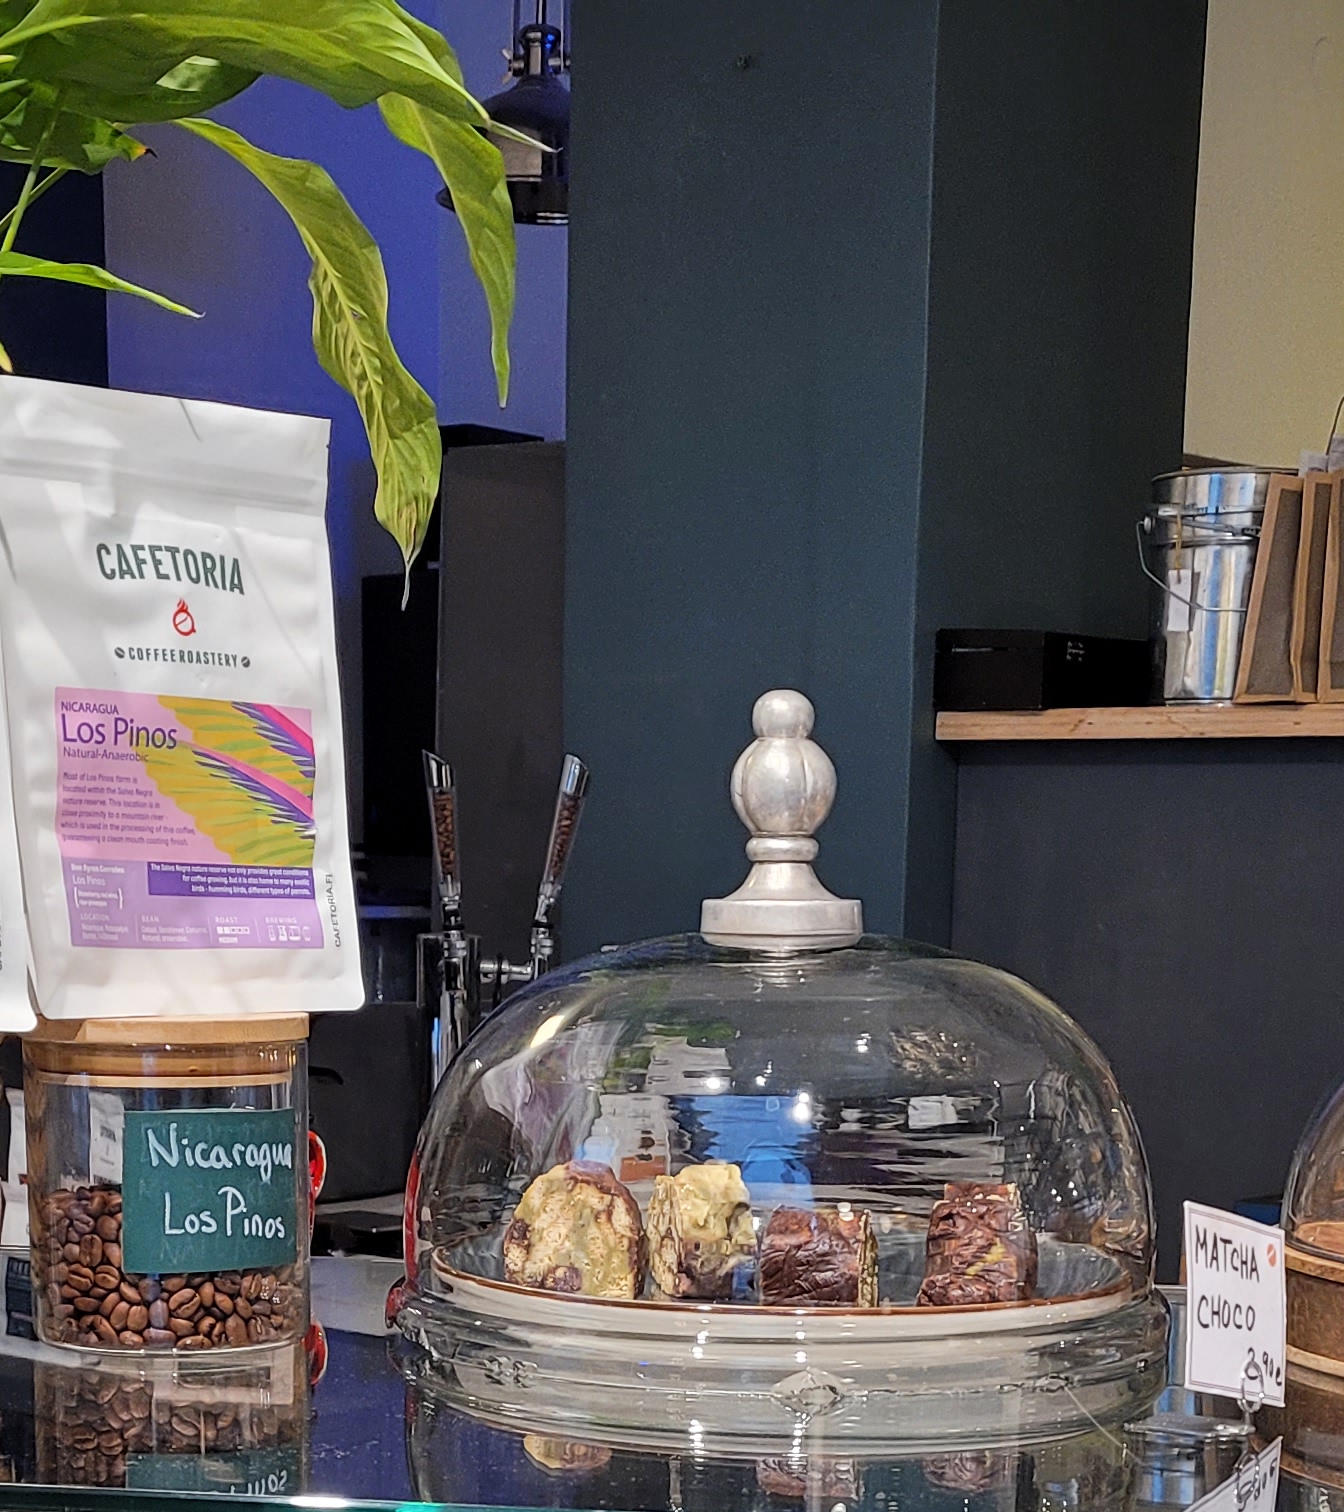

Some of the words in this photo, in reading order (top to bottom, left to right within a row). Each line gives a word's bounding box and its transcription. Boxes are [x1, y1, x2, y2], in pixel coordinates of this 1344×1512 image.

[96, 543, 245, 596] CAFETORIA
[128, 646, 176, 662] COFFEE
[179, 649, 238, 668] ROASTERY
[61, 701, 119, 715] NICARAGUA
[60, 713, 106, 745] Los
[113, 717, 178, 750] Pinos
[63, 747, 149, 763] Natural-Anaerobic
[325, 873, 341, 948] CAFETORIA.FI
[164, 1191, 218, 1235] Los
[217, 1185, 285, 1239] Pinos
[1195, 1225, 1260, 1283] MATCHA
[1197, 1294, 1256, 1331] CHOCO
